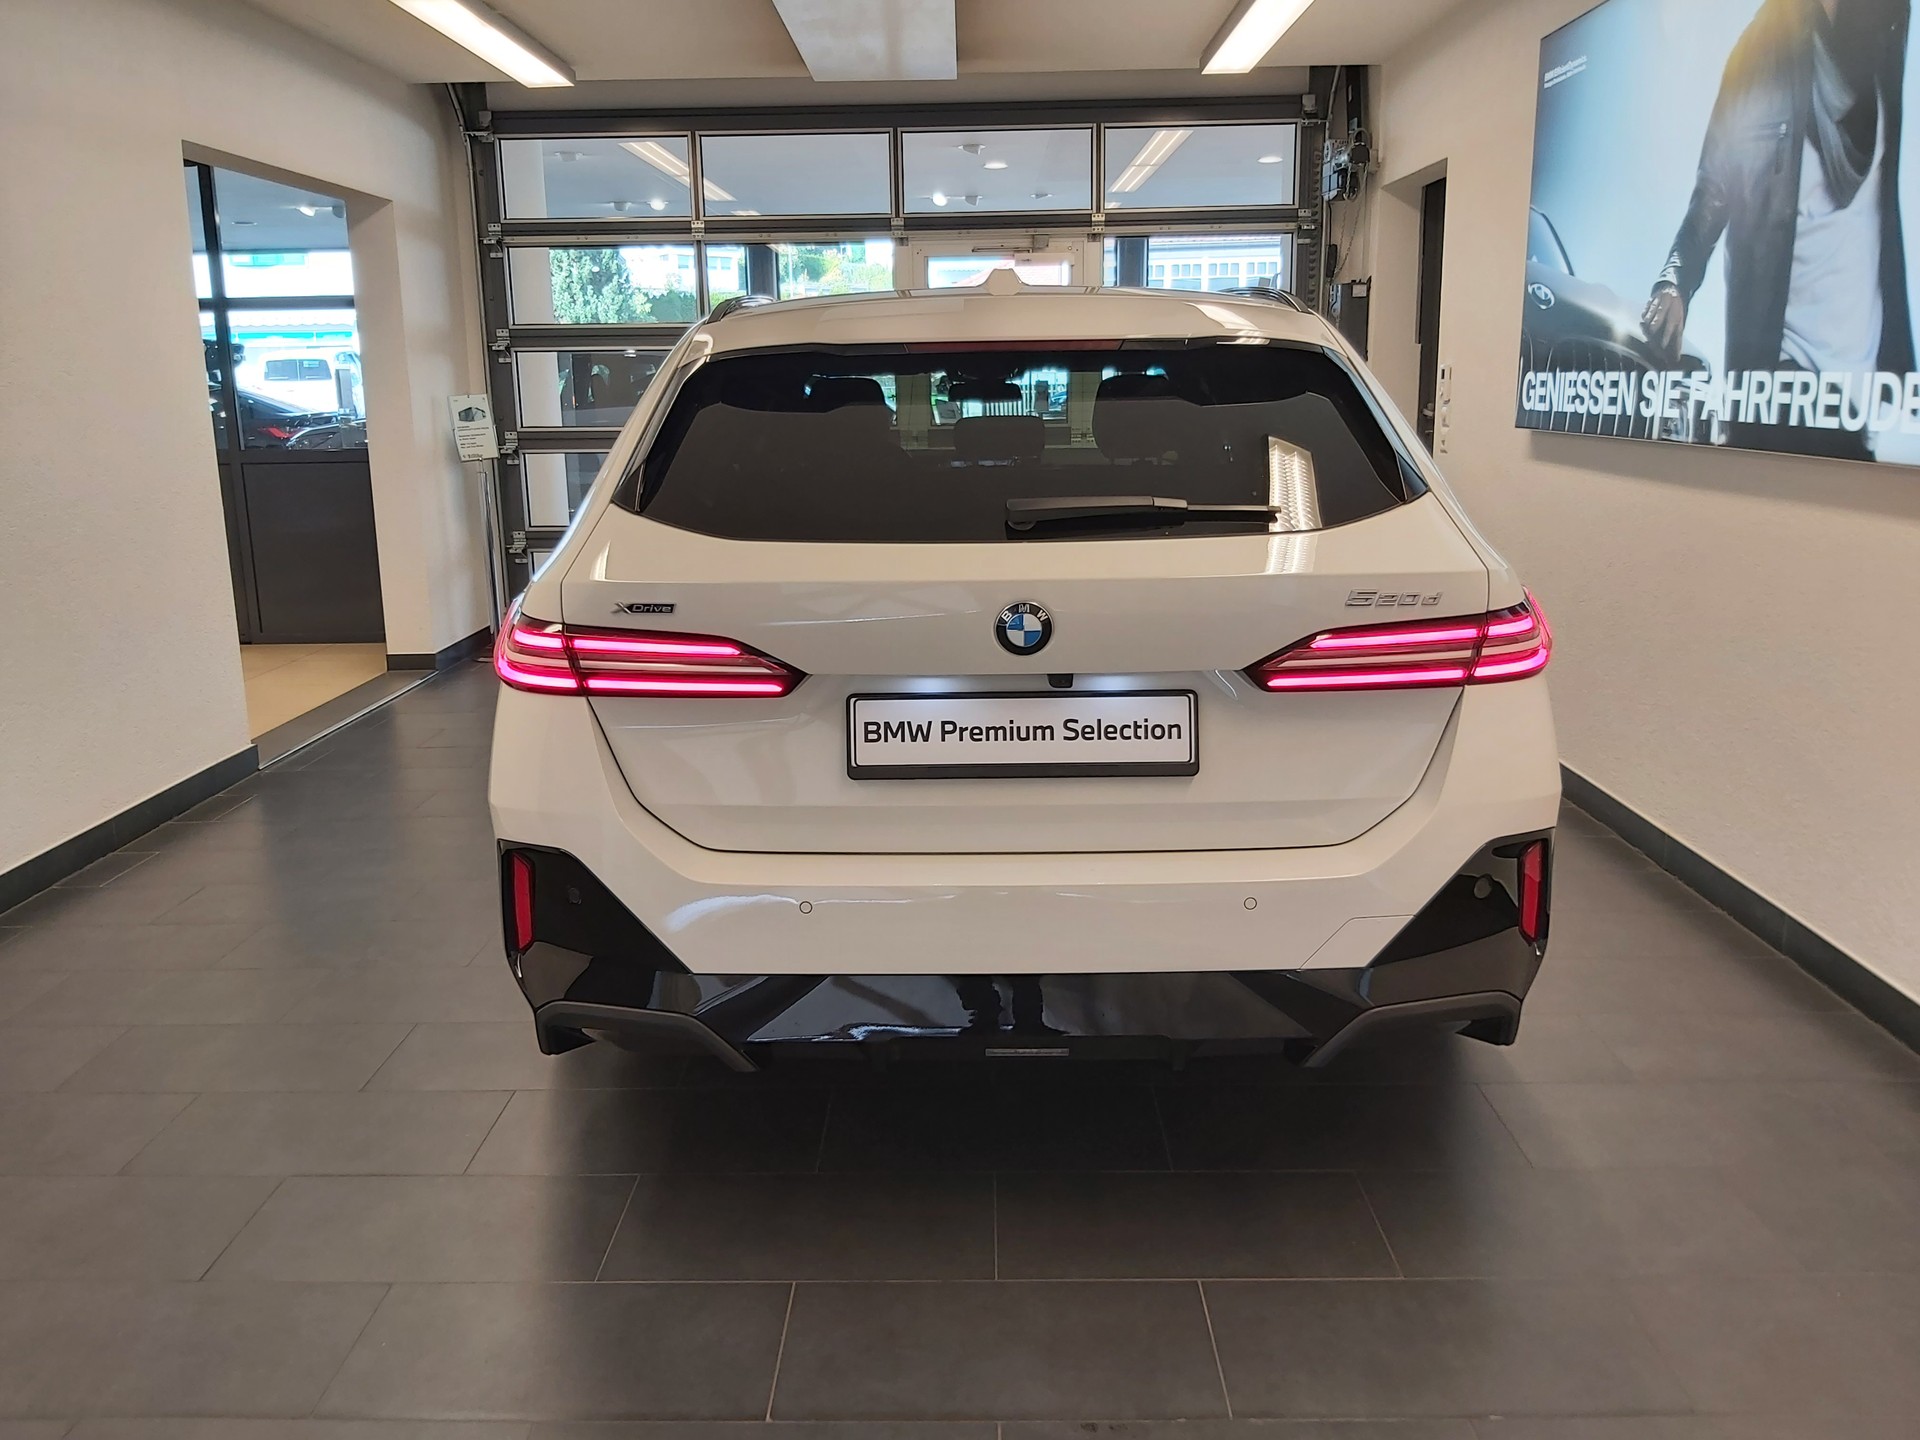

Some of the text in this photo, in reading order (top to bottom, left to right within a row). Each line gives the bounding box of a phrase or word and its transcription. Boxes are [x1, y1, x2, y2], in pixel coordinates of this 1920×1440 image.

[1522, 370, 1920, 434] GENIESSEN SIE FAHRFREUDE
[1345, 588, 1443, 607] 520d
[1000, 603, 1048, 622] BMW
[863, 718, 1182, 743] BMW Premium Selection
